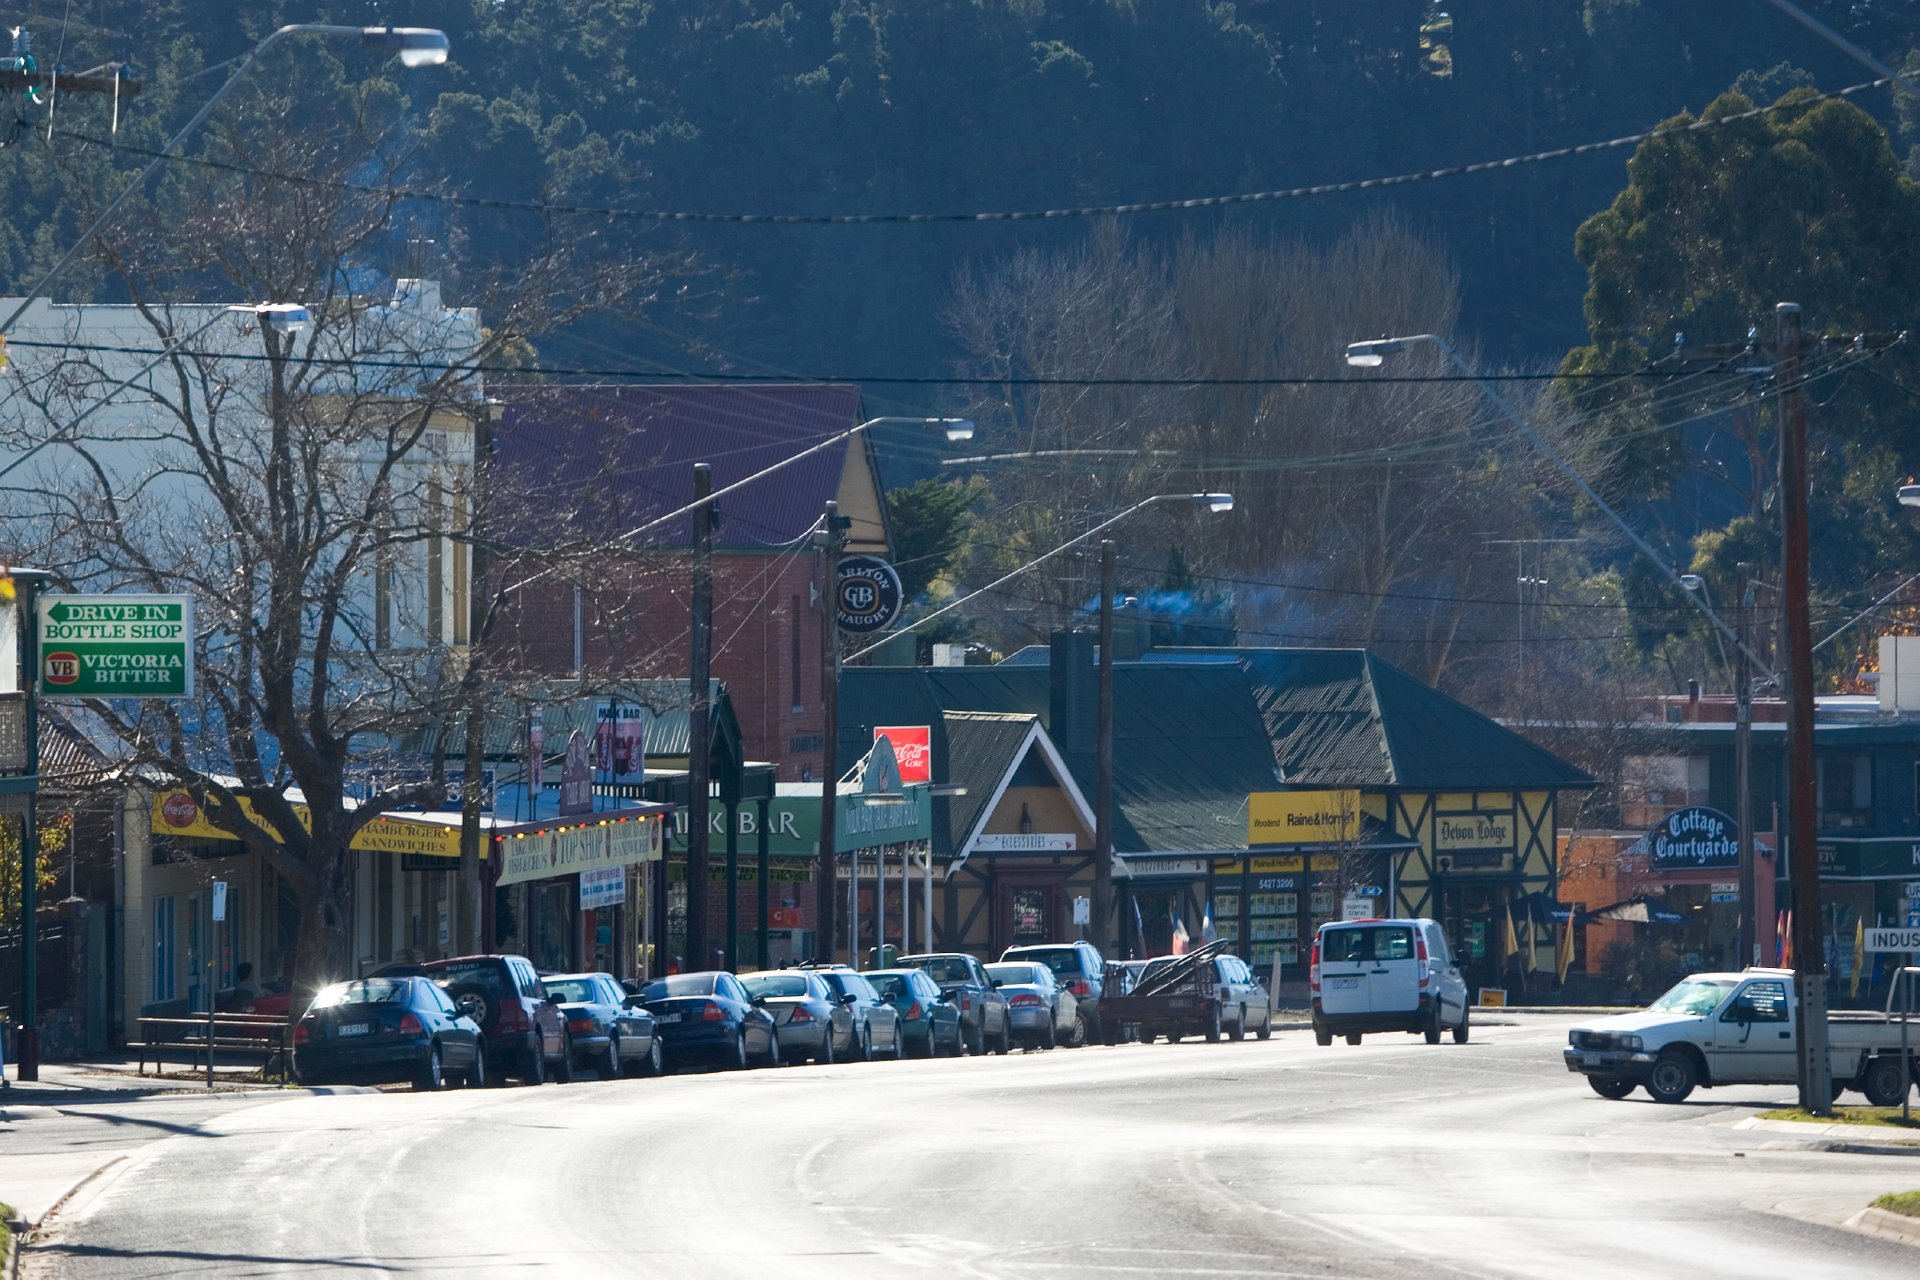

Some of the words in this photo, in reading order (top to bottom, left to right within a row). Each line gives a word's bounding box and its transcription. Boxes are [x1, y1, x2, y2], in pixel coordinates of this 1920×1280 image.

[838, 568, 890, 589] ARLTON
[67, 606, 138, 620] DRIVE
[143, 606, 168, 620] IN
[838, 605, 890, 624] RAUGHT
[45, 625, 126, 639] BOTTLE
[130, 624, 182, 639] SHOP
[51, 661, 75, 676] VB
[82, 654, 183, 668] VICTORIA
[95, 669, 172, 683] BITTER
[623, 708, 640, 719] BAR
[905, 758, 923, 767] Coke
[361, 822, 450, 839] HAMBURGERS
[1254, 818, 1280, 828] Woodend
[1669, 809, 1723, 839] Cottage
[1441, 820, 1474, 841] Devon
[1476, 819, 1507, 845] Lodge
[362, 837, 446, 853] SANDWICHES
[559, 834, 578, 864] TOP
[579, 830, 604, 862] SHOP
[1656, 835, 1739, 864] Courtyards
